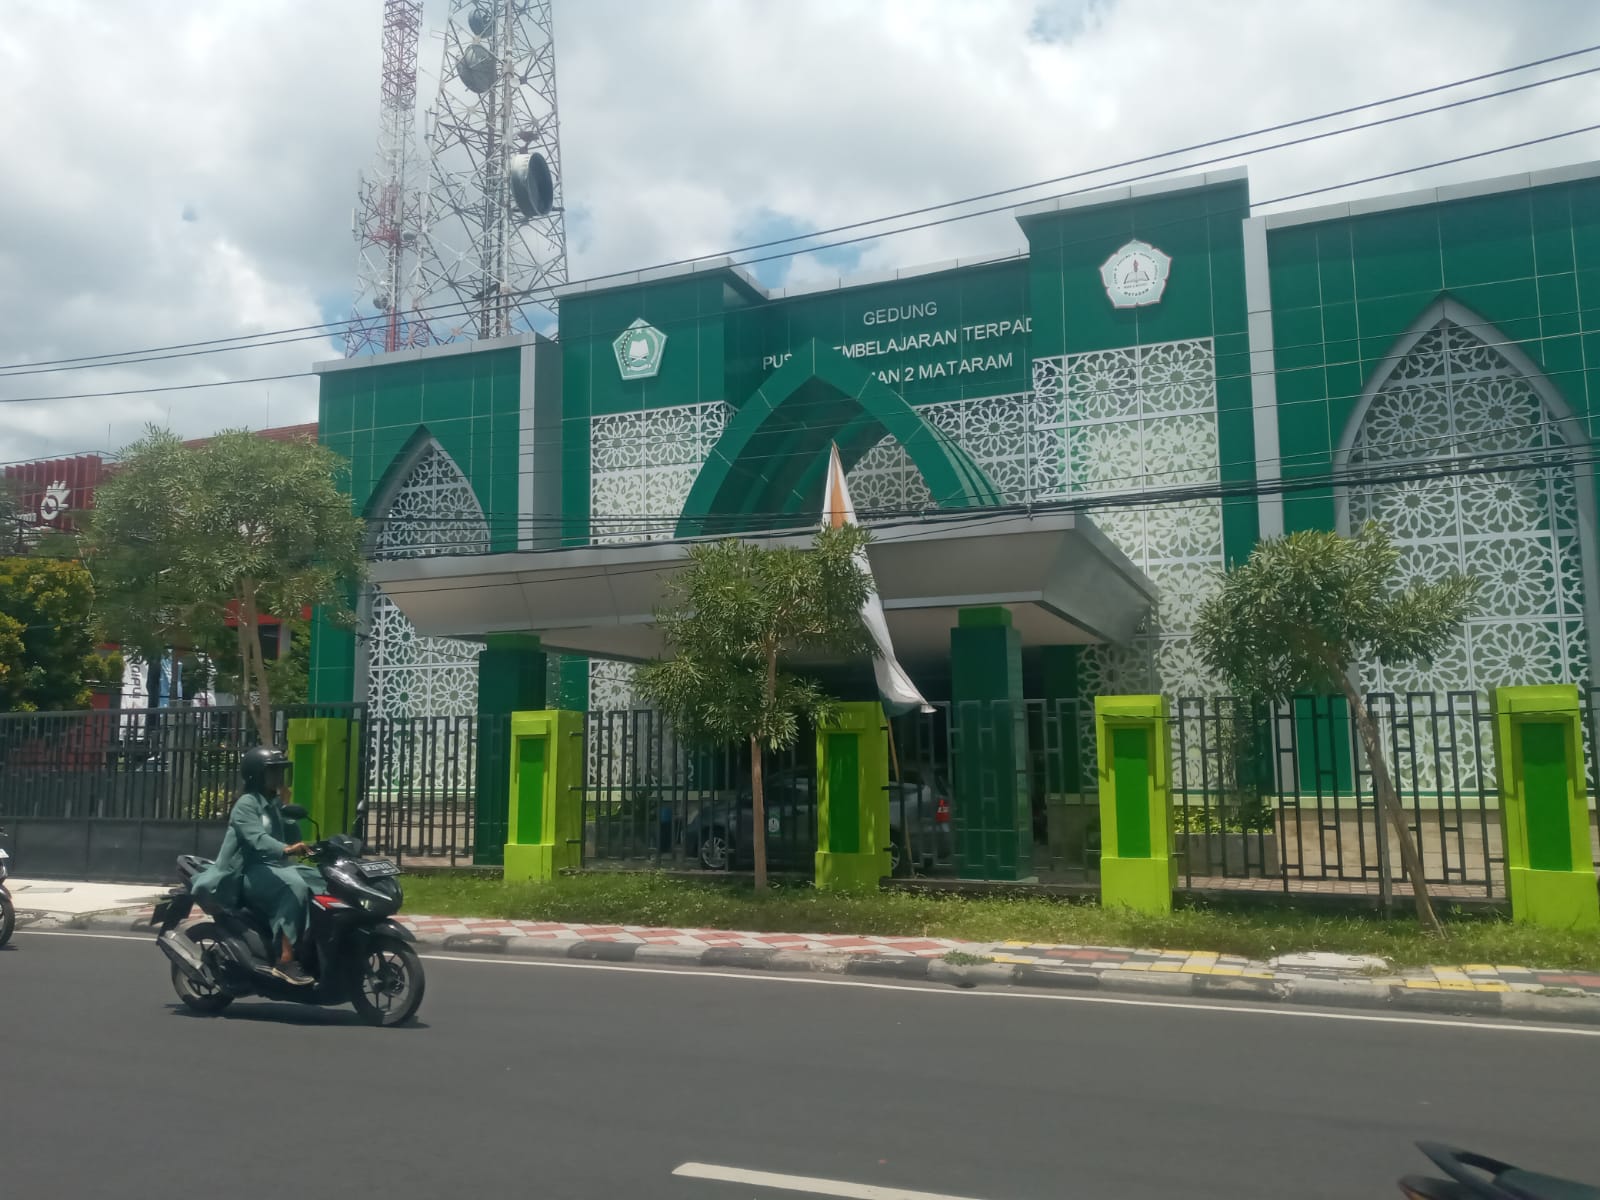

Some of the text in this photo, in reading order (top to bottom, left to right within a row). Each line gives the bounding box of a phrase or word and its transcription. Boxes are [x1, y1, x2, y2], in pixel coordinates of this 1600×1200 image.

[863, 301, 938, 326] GEDUNG
[832, 328, 958, 359] MBELAJARAN
[872, 352, 1013, 385] AN 2 MATARAM
